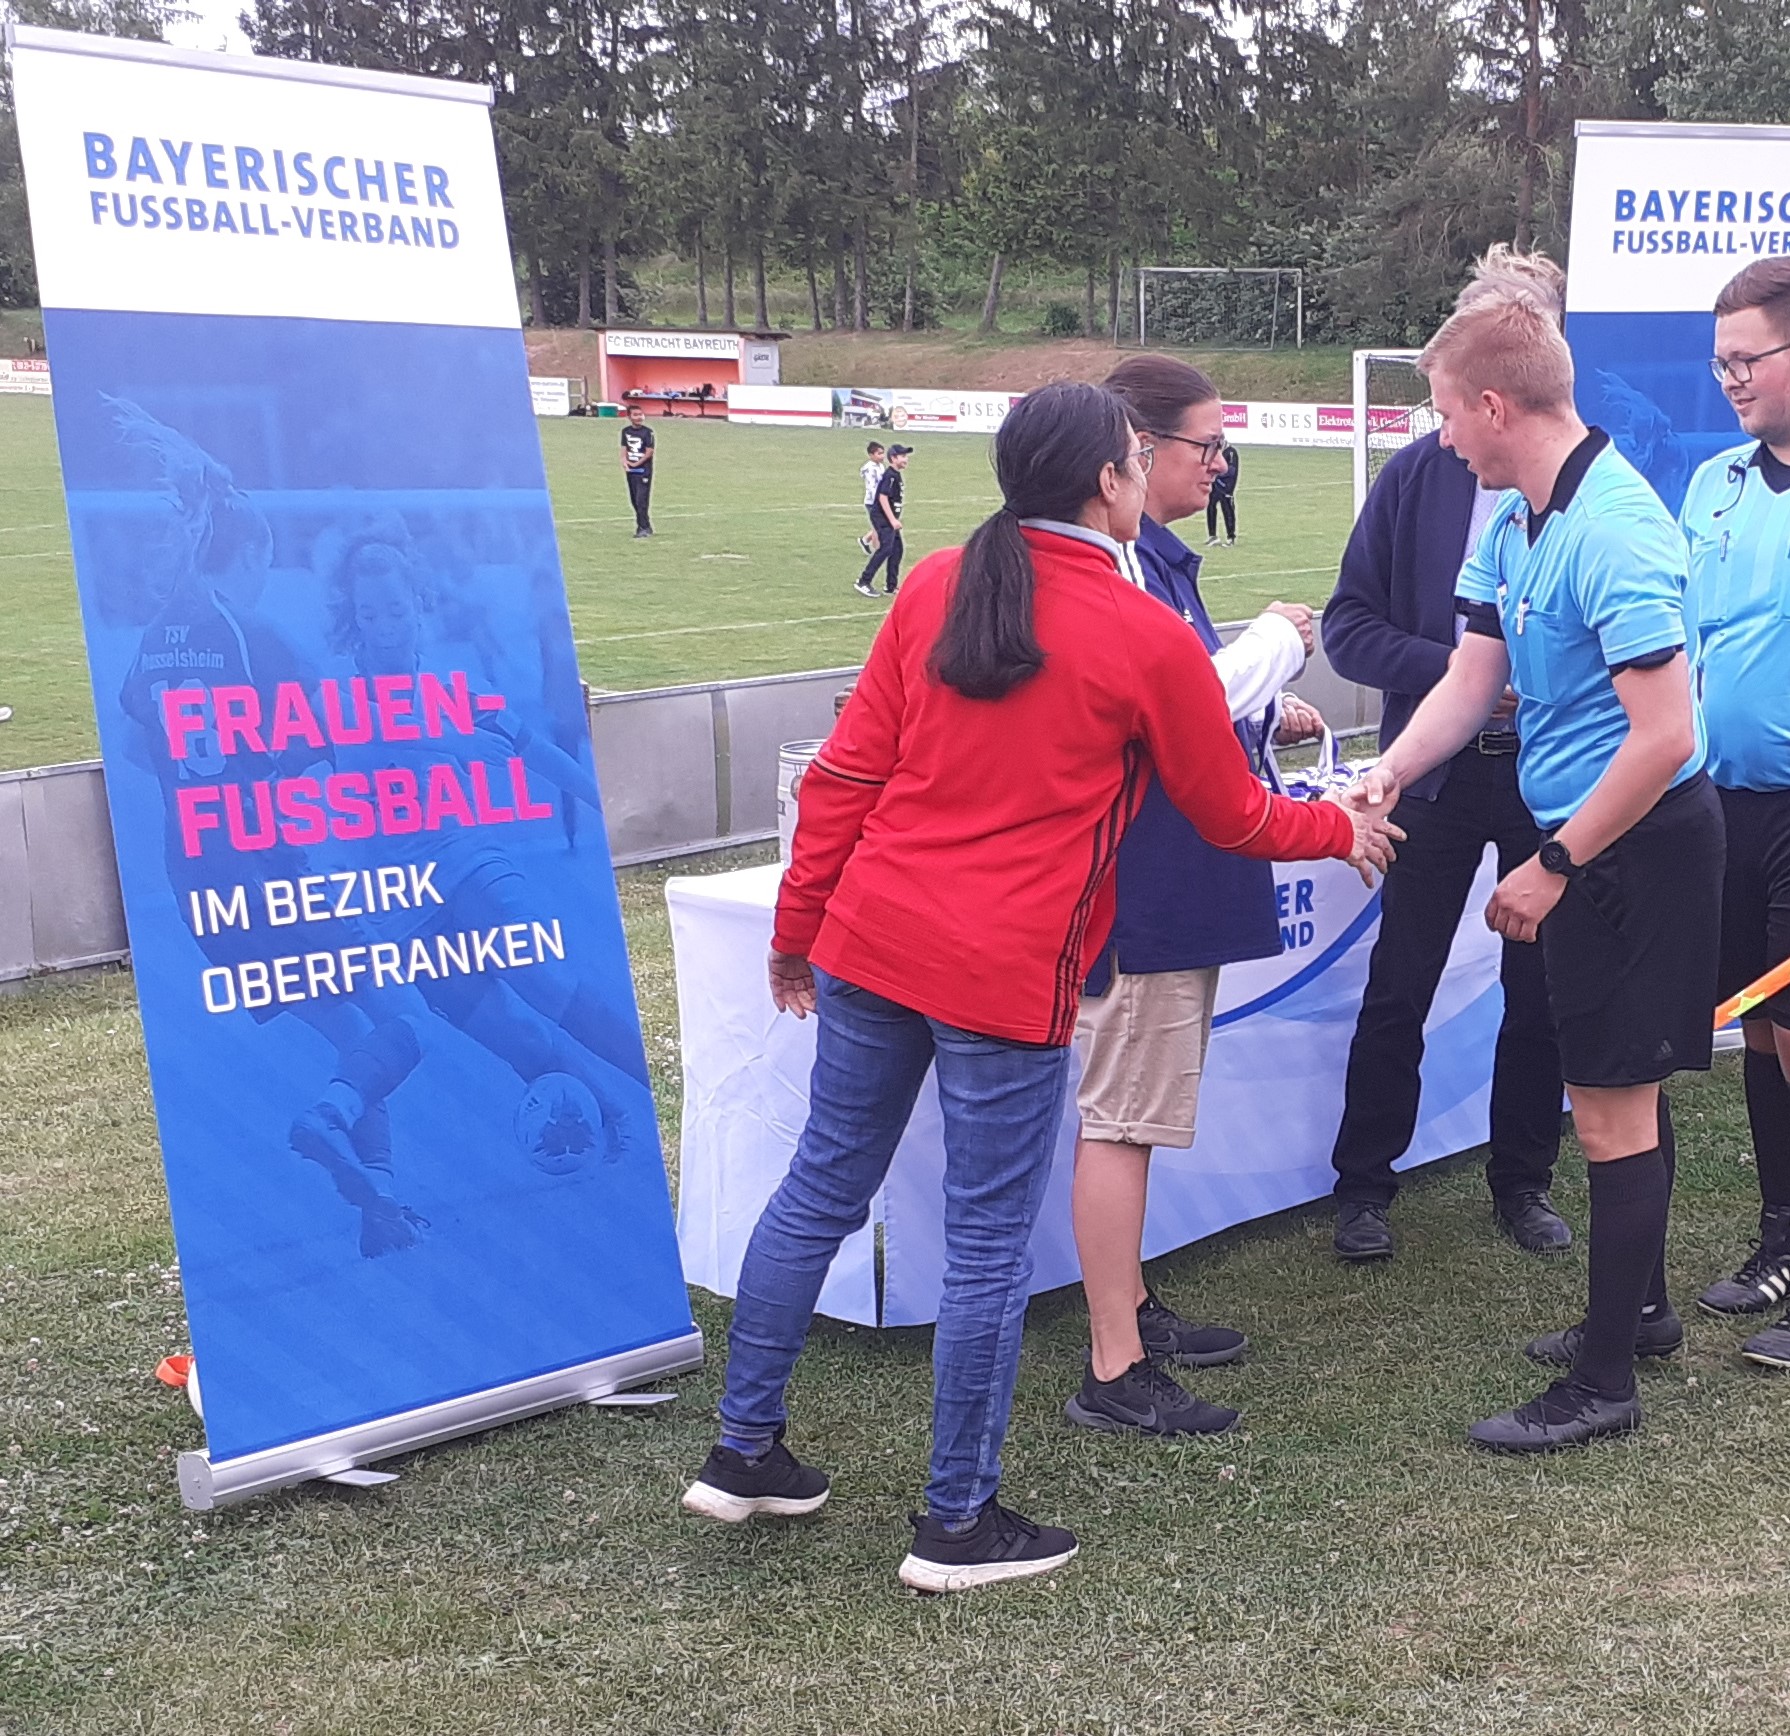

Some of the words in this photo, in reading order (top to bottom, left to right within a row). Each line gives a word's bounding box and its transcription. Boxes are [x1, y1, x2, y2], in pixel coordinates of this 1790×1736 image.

[83, 131, 455, 209] BAYERISCHER
[89, 190, 460, 250] FUSSBALL-VERBAND
[623, 336, 682, 349] EINTRACHT
[684, 338, 739, 351] BAYREUTH
[161, 671, 506, 760] FRAUEN-
[176, 756, 553, 859] FUSSBALL
[189, 885, 251, 938] IM
[264, 861, 445, 927] BEZIRK
[201, 918, 567, 1015] OBERFRANKEN
